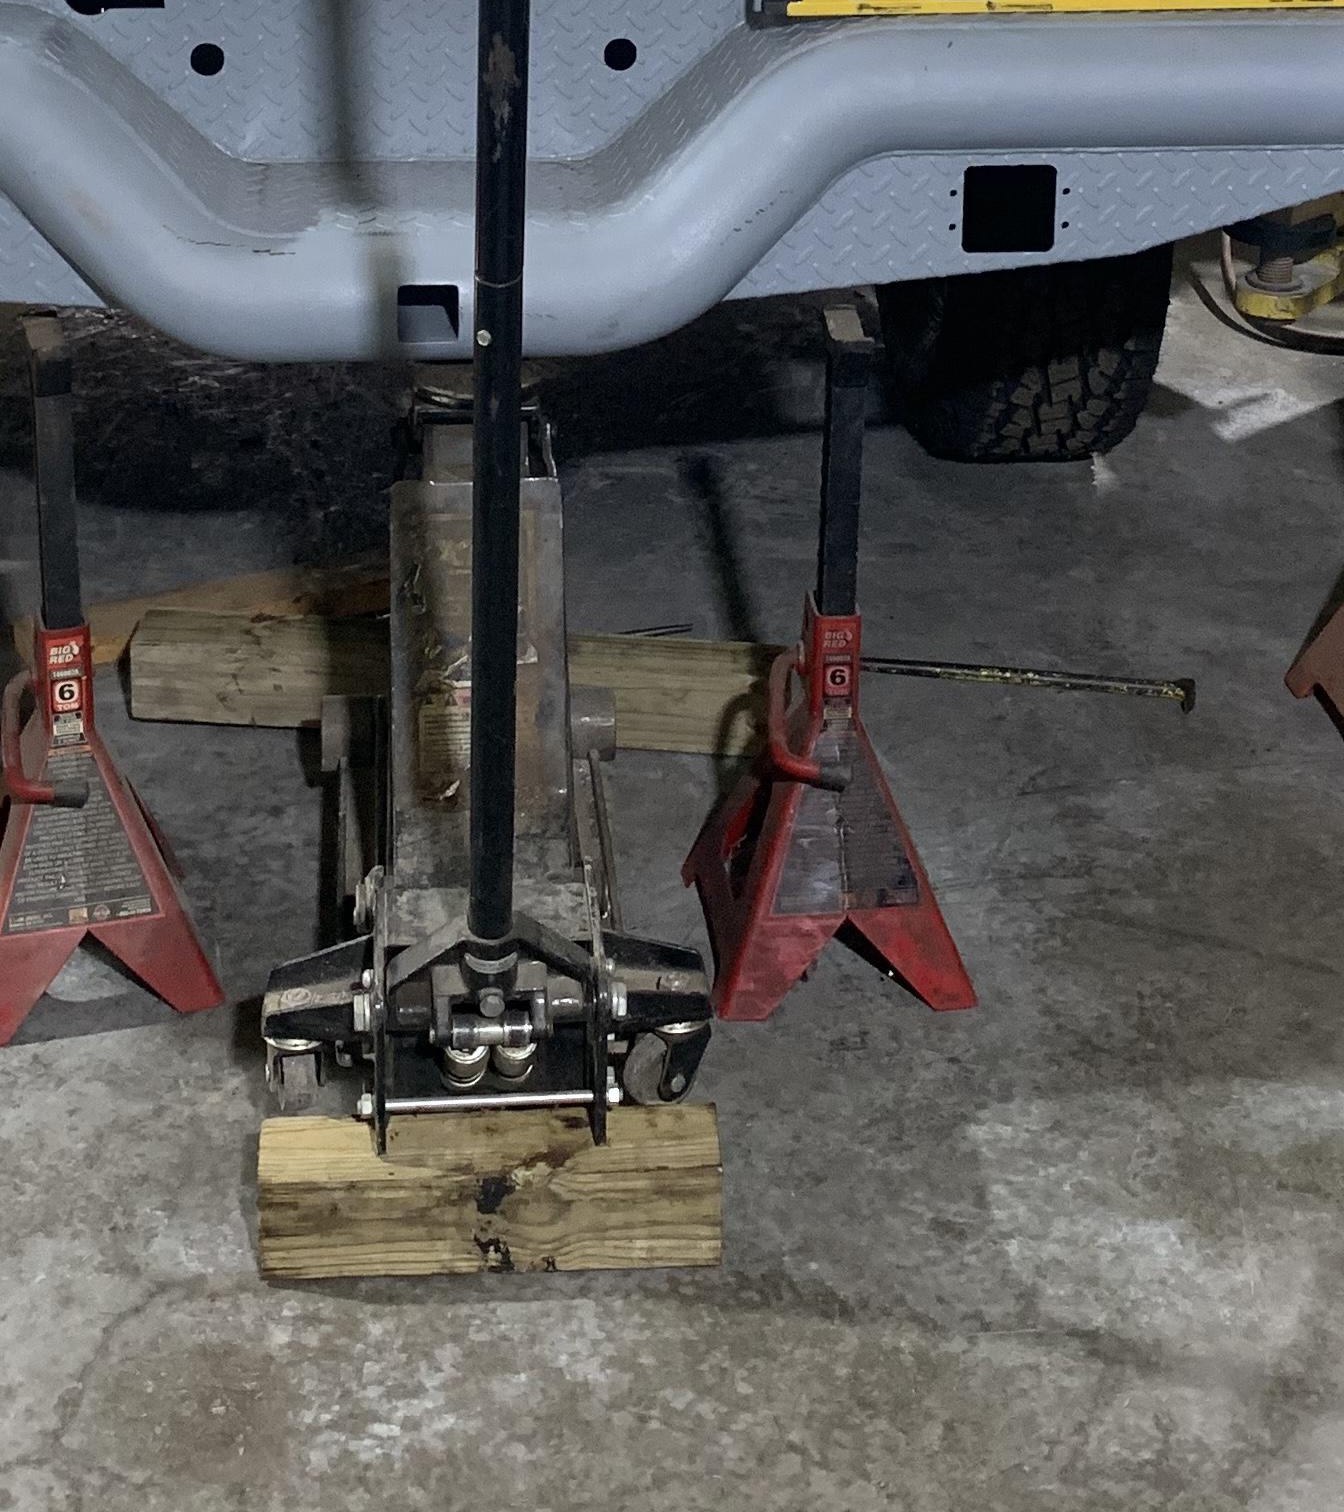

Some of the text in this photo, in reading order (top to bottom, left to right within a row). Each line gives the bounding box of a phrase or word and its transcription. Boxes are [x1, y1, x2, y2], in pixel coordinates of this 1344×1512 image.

[50, 645, 71, 655] BIG
[49, 653, 74, 664] RED
[829, 669, 846, 686] 6
[58, 683, 75, 701] 6
[56, 702, 79, 712] TON
